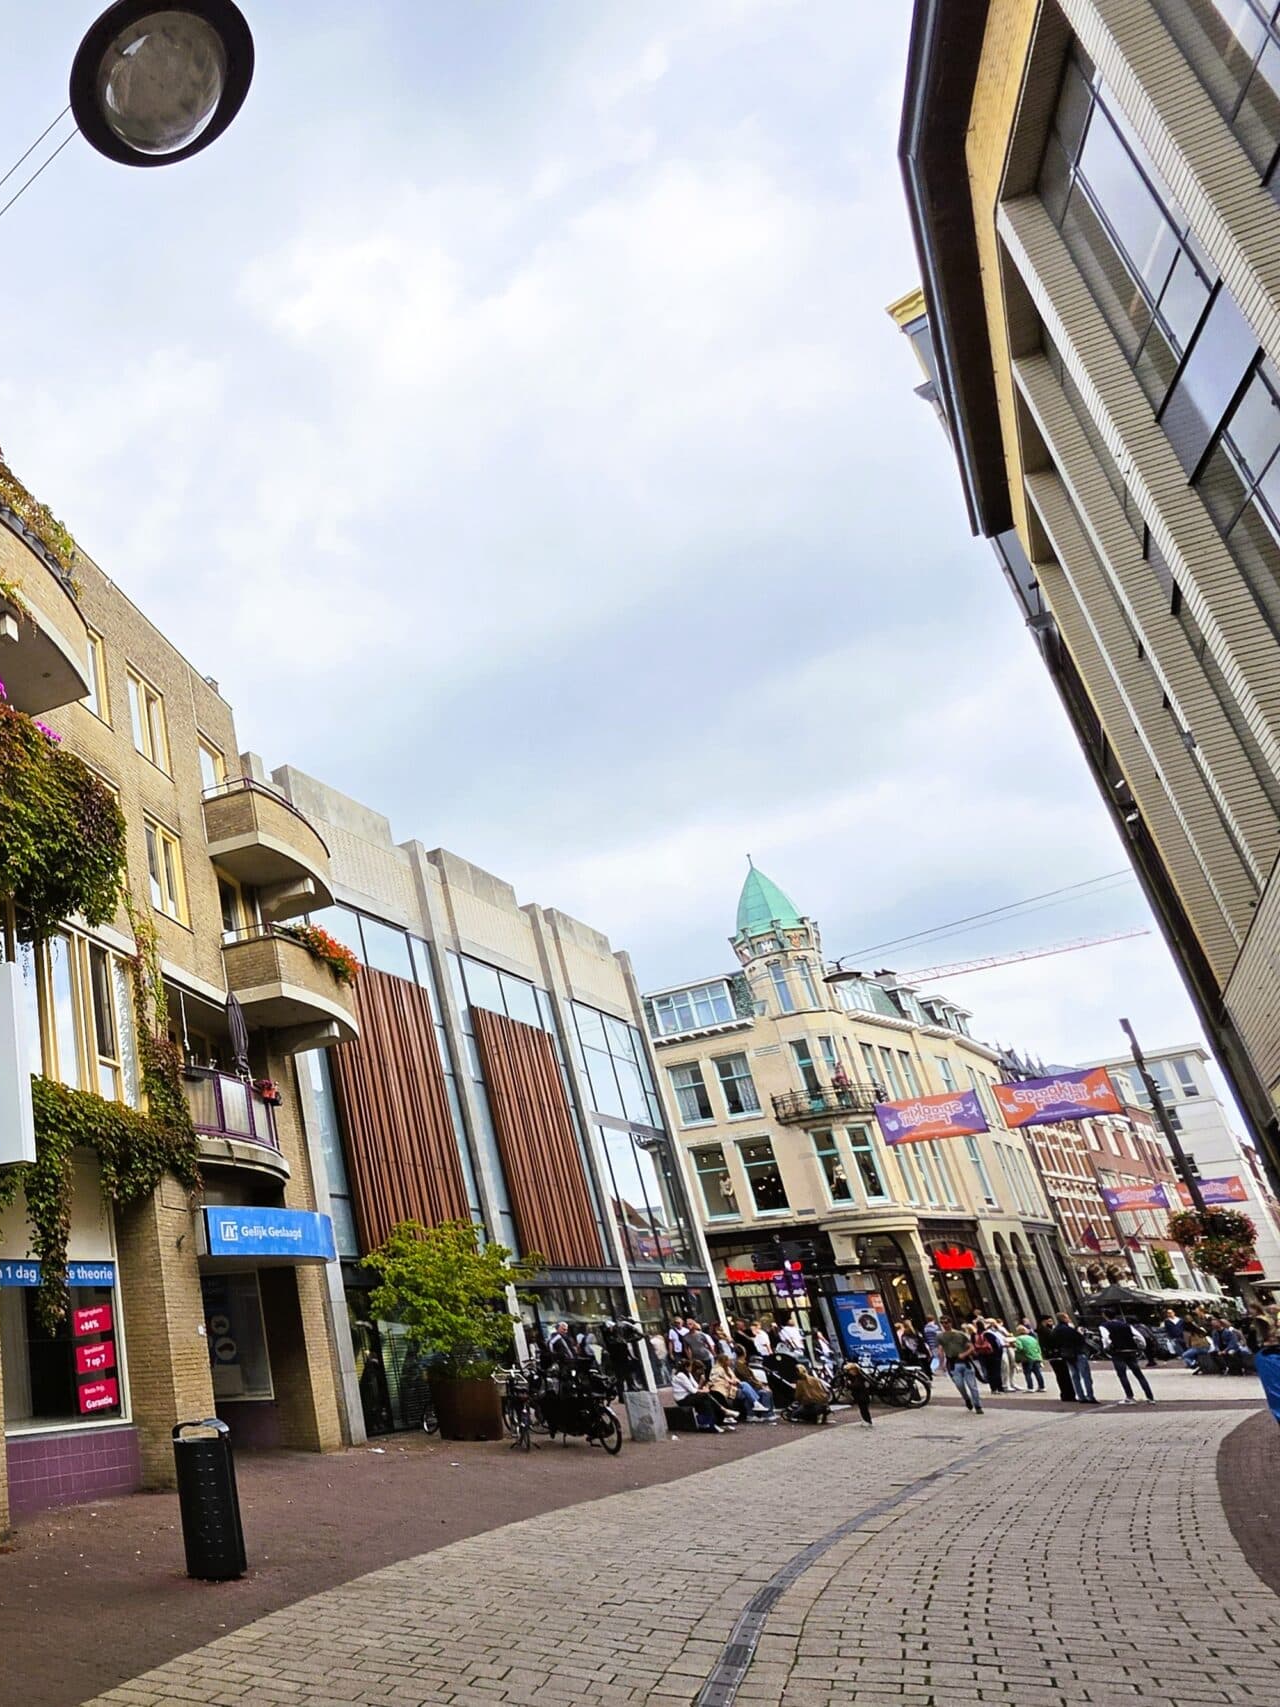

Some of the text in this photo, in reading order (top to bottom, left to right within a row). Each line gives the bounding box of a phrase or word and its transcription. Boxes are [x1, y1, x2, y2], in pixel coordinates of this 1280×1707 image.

[240, 1225, 303, 1241] Gelijk Geslaagd
[6, 1266, 13, 1279] 1
[15, 1265, 38, 1282] dag
[77, 1265, 113, 1280] theorie
[85, 1358, 91, 1368] 7
[100, 1353, 106, 1363] 7
[85, 1395, 113, 1409] Garantie
